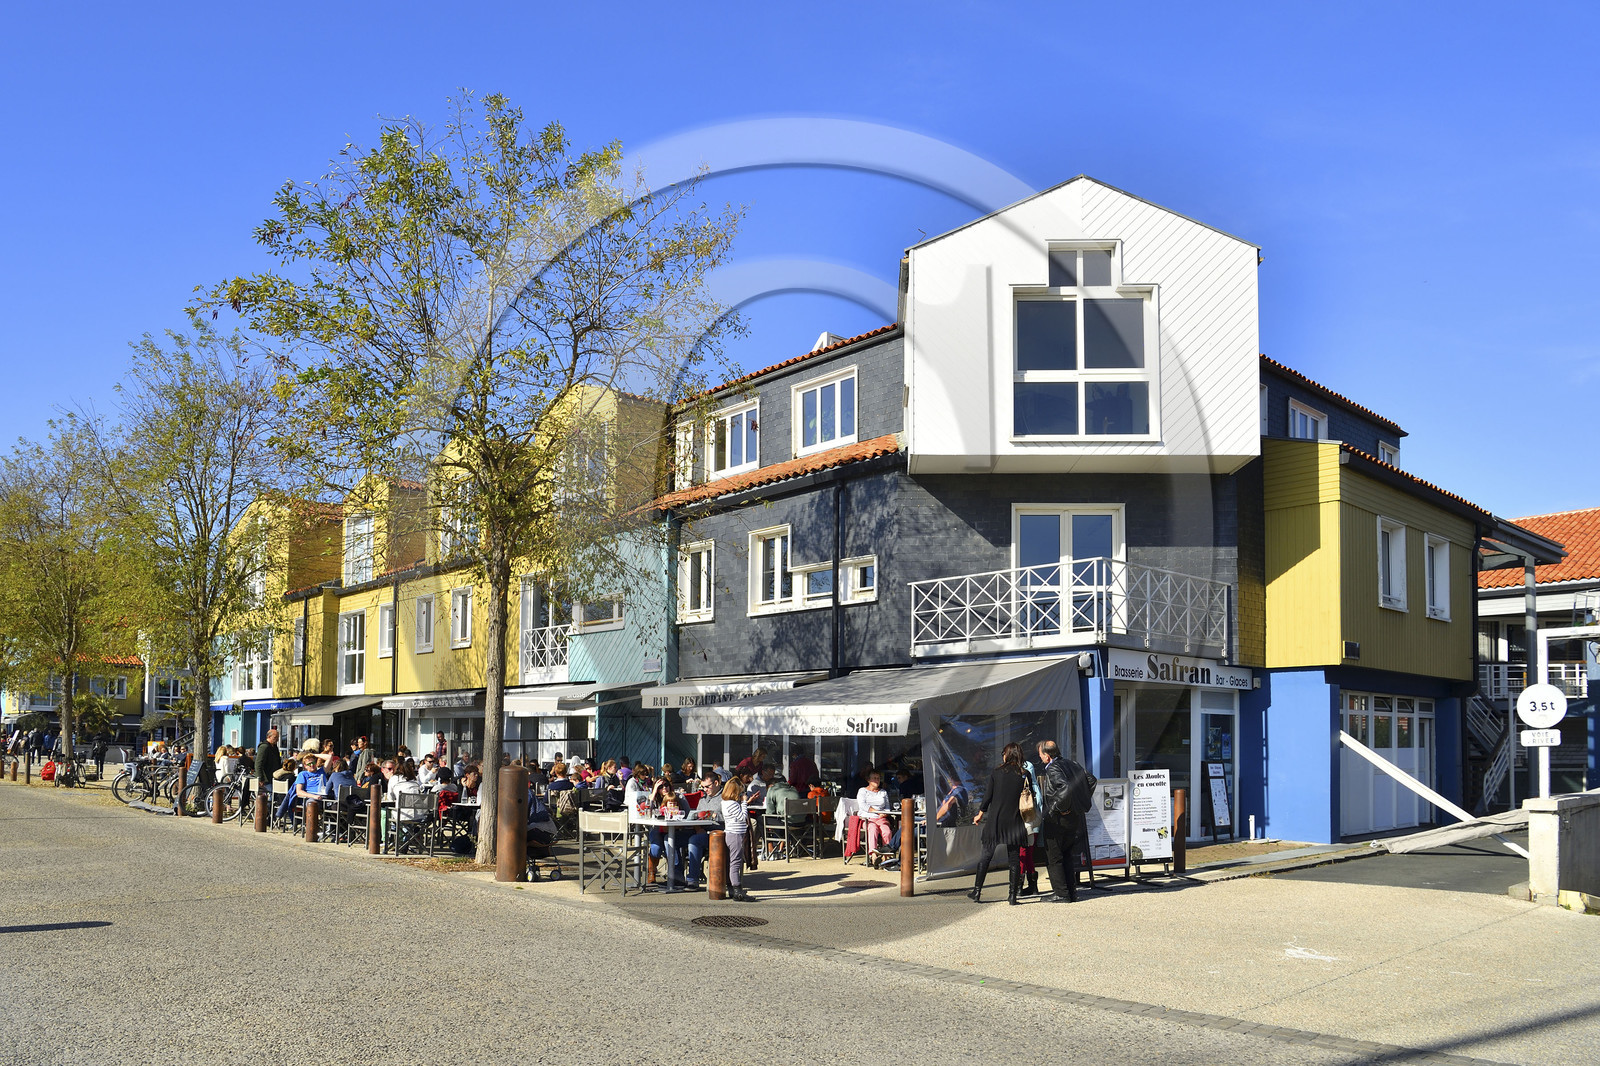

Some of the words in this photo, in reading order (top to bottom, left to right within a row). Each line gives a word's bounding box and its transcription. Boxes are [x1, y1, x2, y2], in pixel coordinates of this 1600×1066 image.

[1114, 665, 1144, 679] Brasserie
[1147, 653, 1211, 685] Safran
[1215, 674, 1225, 685] Bar
[1229, 675, 1248, 688] Glaces
[653, 696, 669, 707] BAR
[678, 692, 734, 707] RESTAURANT
[811, 725, 840, 735] Brasserie
[846, 716, 898, 734] Safran
[1145, 772, 1166, 780] Moules
[1145, 780, 1167, 788] cocotte
